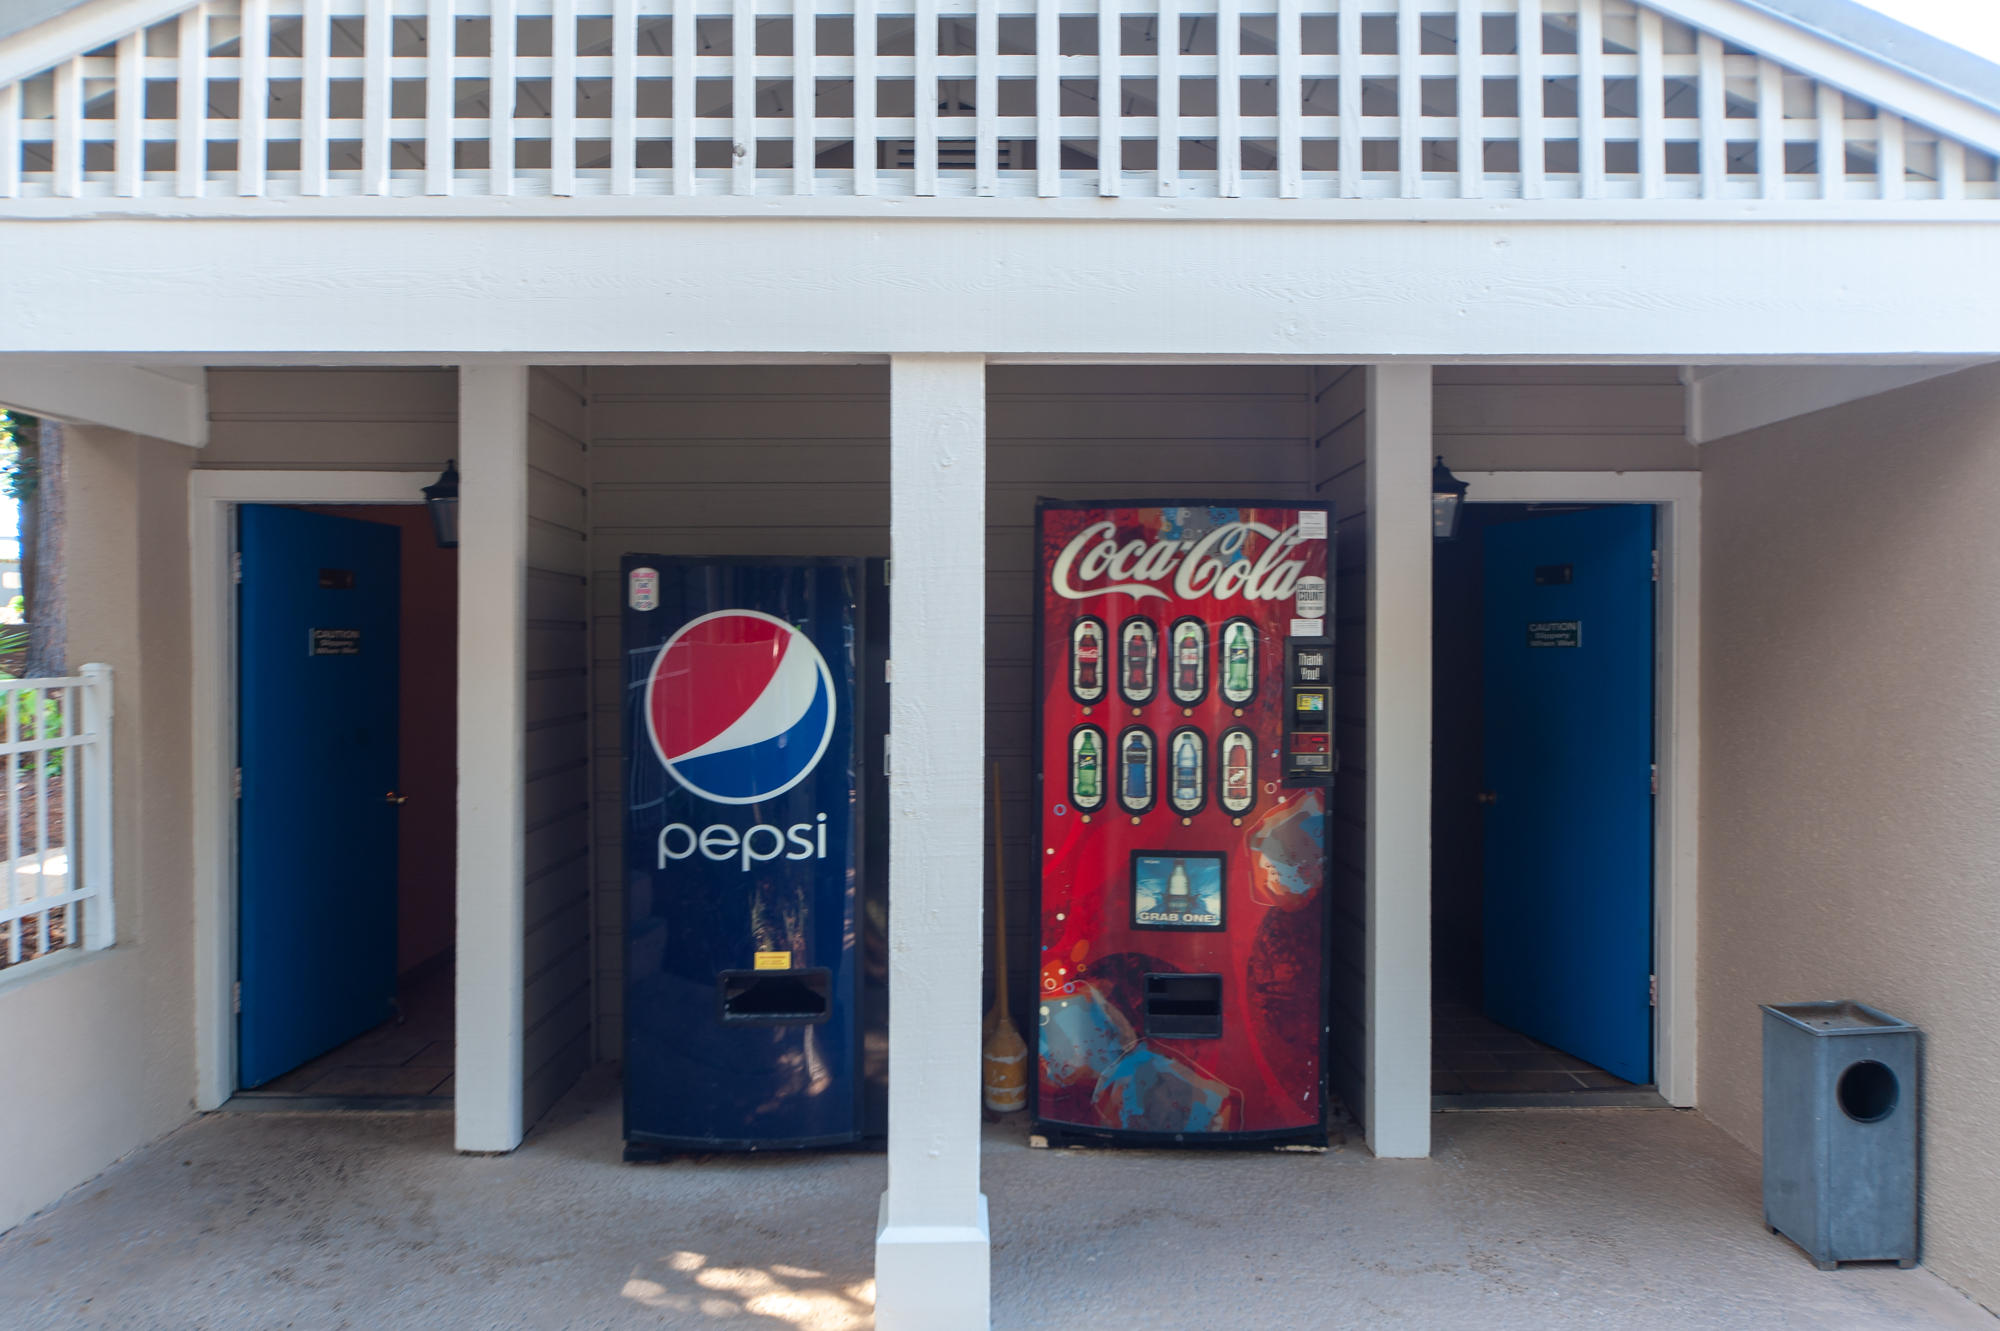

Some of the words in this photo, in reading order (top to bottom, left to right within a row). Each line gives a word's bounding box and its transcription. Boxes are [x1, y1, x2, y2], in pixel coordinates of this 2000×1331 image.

[1051, 520, 1309, 602] Coca-Cola
[1529, 622, 1577, 631] CAUTION
[315, 630, 360, 638] CAUTION
[1298, 652, 1324, 666] Thank
[657, 812, 828, 872] pepsi
[1139, 912, 1179, 922] GRAB
